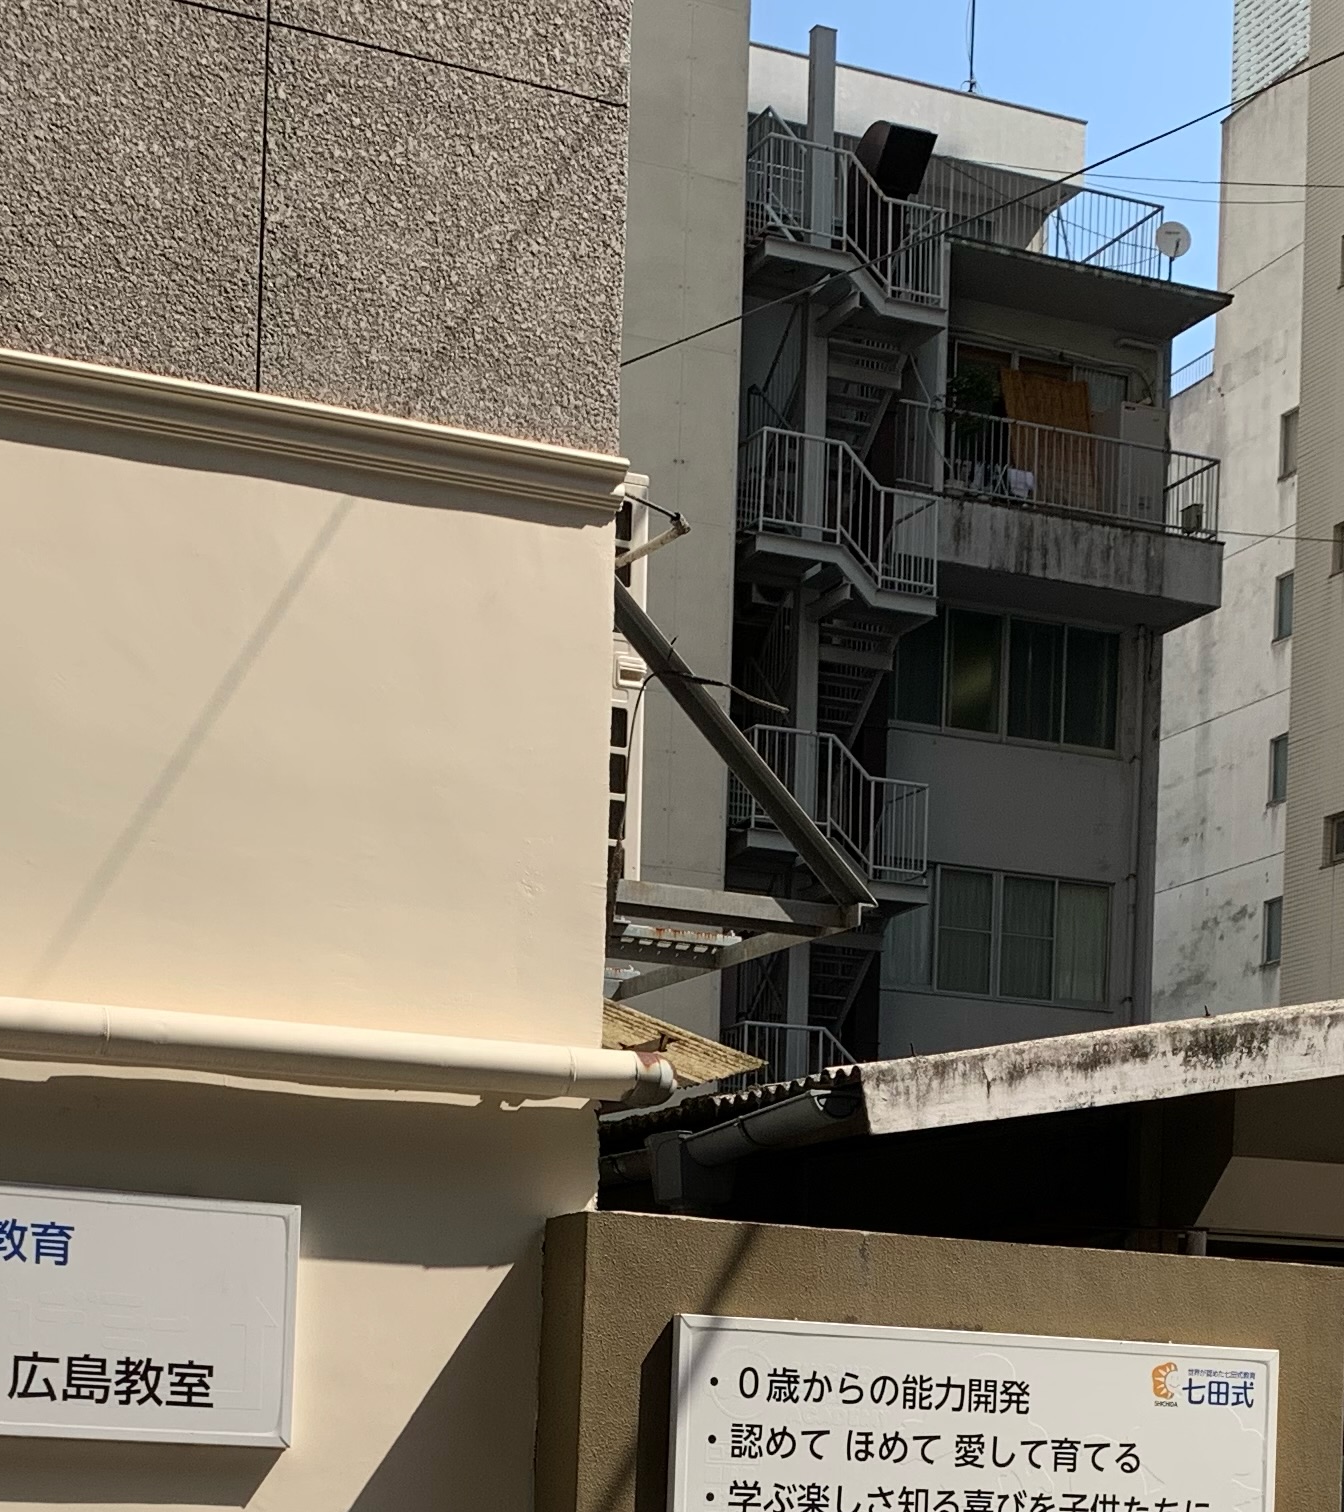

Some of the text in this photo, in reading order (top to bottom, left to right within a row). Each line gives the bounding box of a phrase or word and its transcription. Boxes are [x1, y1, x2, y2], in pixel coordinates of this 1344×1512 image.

[8, 1352, 214, 1409] 広島教室
[1182, 1377, 1255, 1408] 七田式
[846, 1430, 941, 1465] ほめて
[954, 1433, 1141, 1474] 愛して育てる
